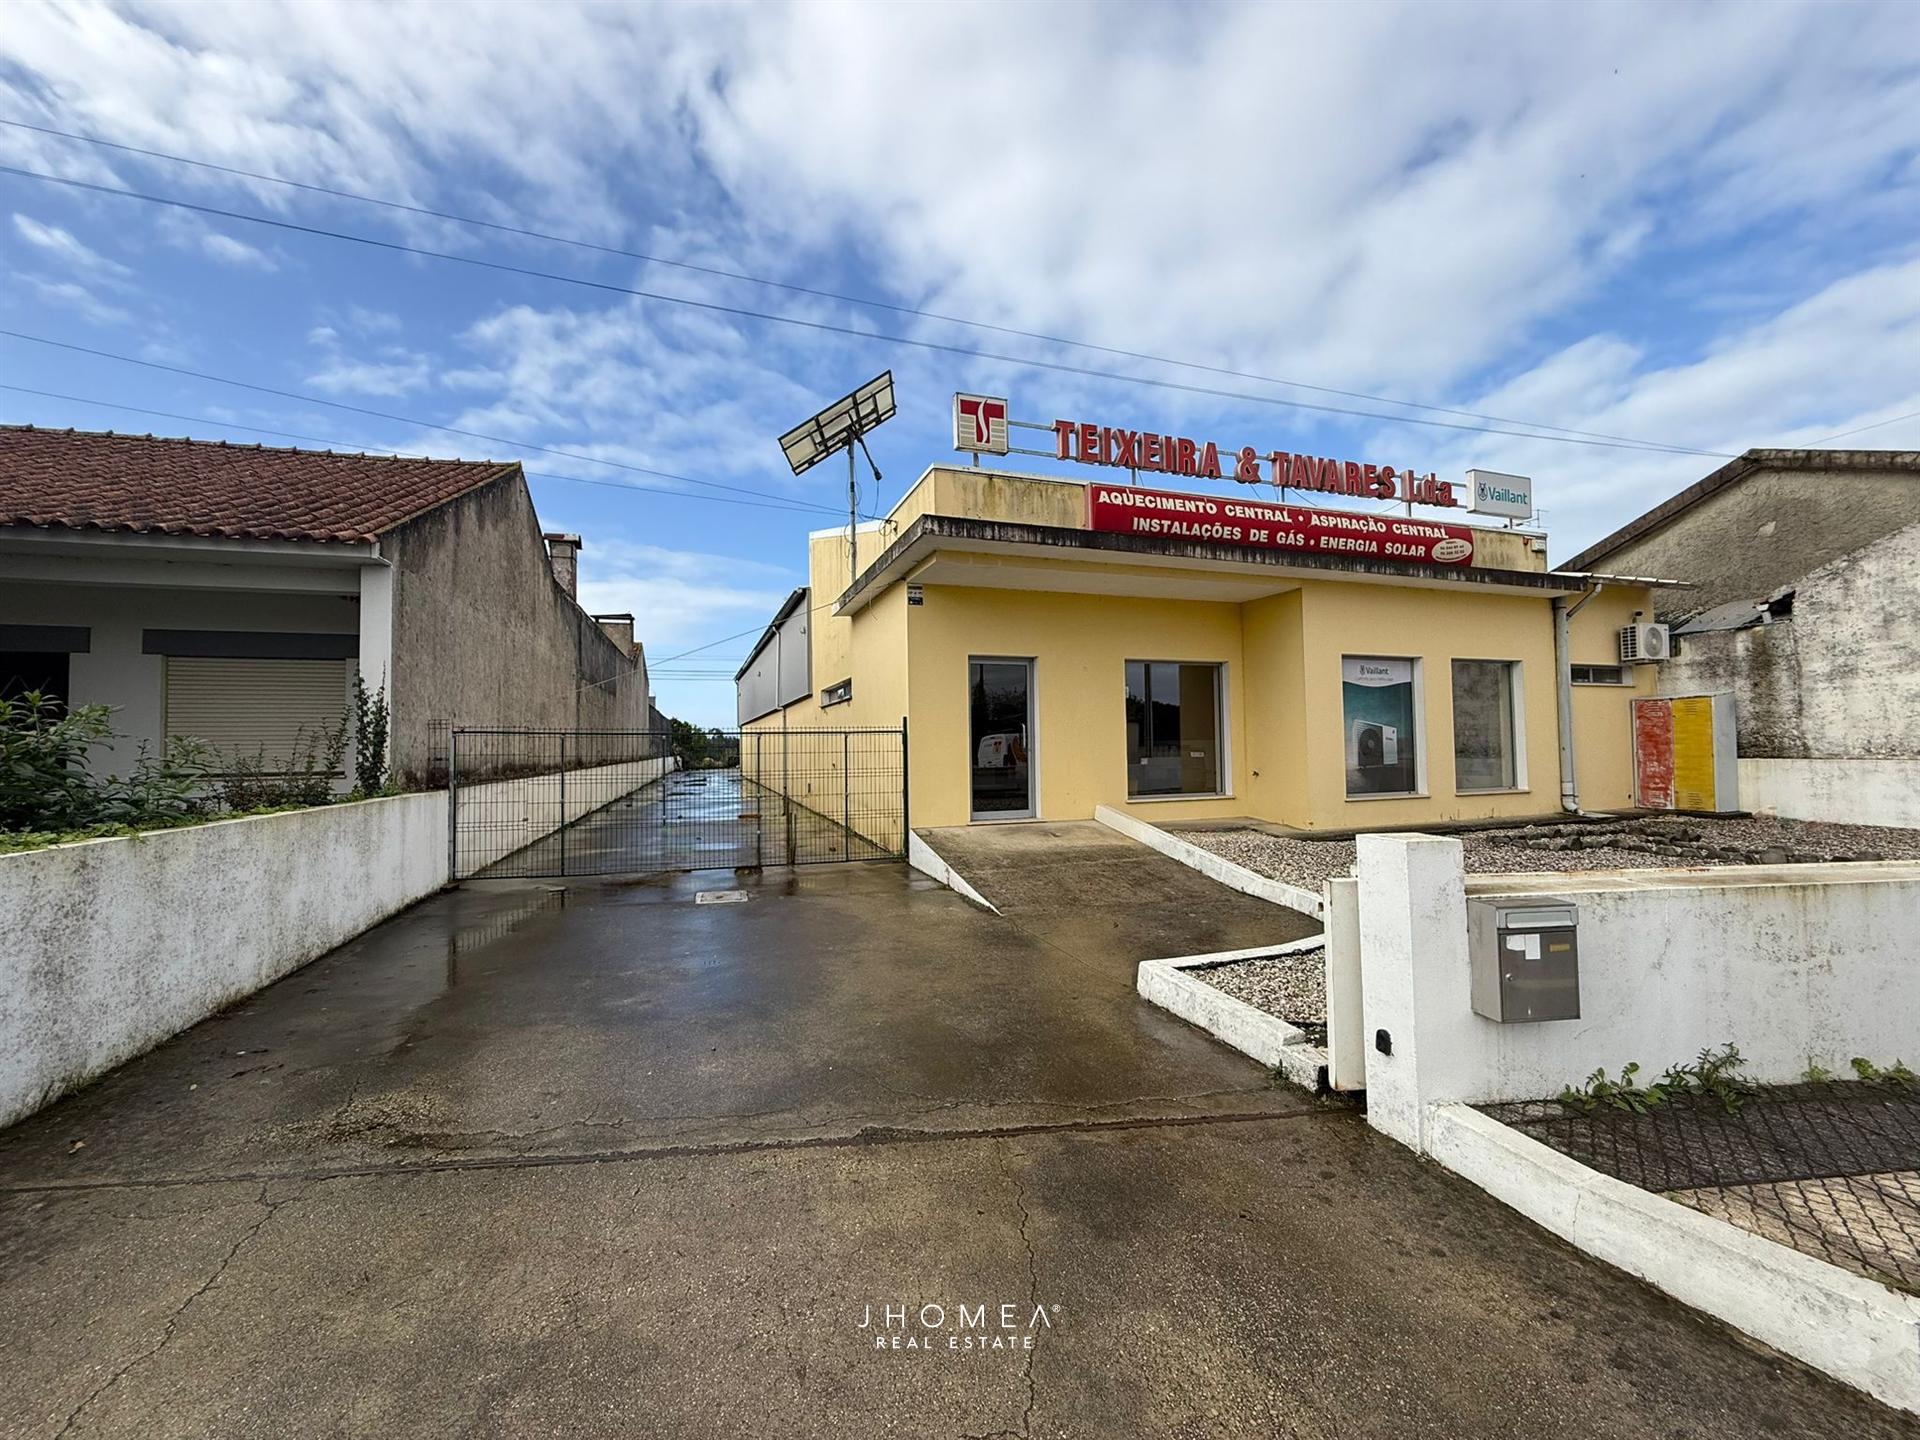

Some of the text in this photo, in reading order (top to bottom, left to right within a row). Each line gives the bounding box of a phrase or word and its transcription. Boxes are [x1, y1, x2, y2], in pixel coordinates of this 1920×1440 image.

[1052, 419, 1222, 480] TEIXEIRA
[1235, 447, 1261, 484] &
[1271, 451, 1397, 499] TAVARES
[1098, 490, 1449, 539] AQUECIMENTO CENTRAL ASPIRAÇÃO CENTRAL
[1487, 486, 1528, 505] Vaillant
[1132, 517, 1242, 540] INSTALAÇÕES
[1249, 528, 1269, 542] DE
[1275, 530, 1305, 546] GÁS
[1319, 536, 1378, 553] ENERGIA
[1384, 542, 1426, 557] SOLAR
